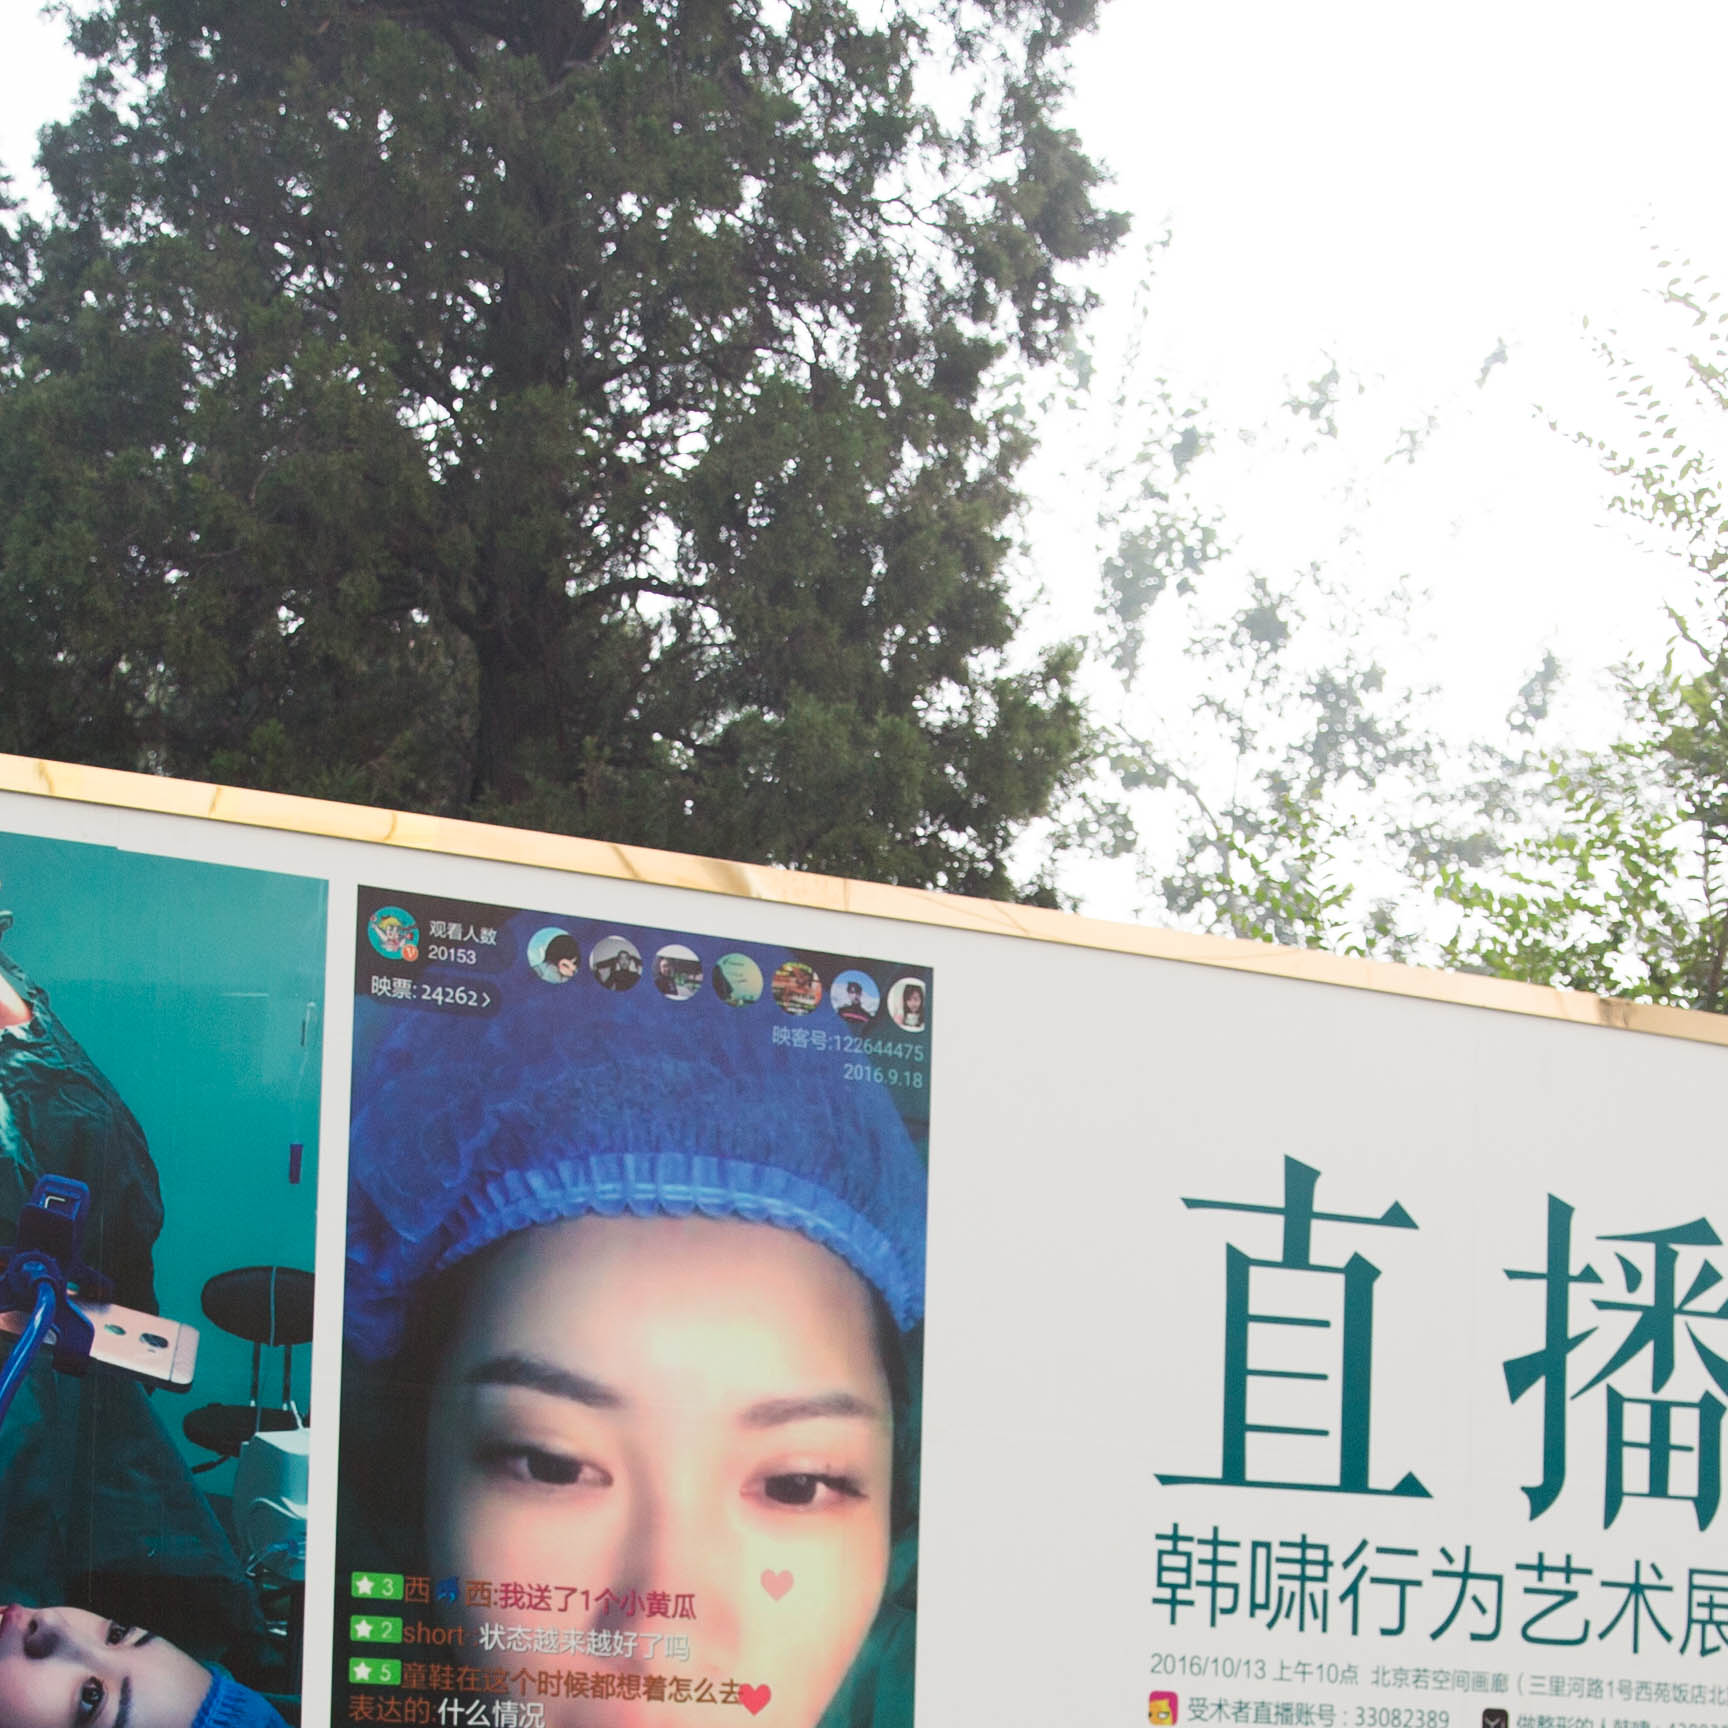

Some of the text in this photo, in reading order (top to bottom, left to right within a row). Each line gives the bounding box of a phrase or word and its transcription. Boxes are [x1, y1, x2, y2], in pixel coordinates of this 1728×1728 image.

[428, 920, 498, 946] 观看人数
[427, 944, 477, 965] 20153
[772, 1025, 925, 1063] 映客号:122644475
[843, 1063, 923, 1089] 2016.9.18
[382, 1578, 394, 1596] 3
[381, 1621, 393, 1639] 2
[403, 1620, 464, 1646] short
[379, 1664, 392, 1682] 5
[1150, 1652, 1267, 1681] 2016/10/13
[1272, 1659, 1360, 1685] 上午10点
